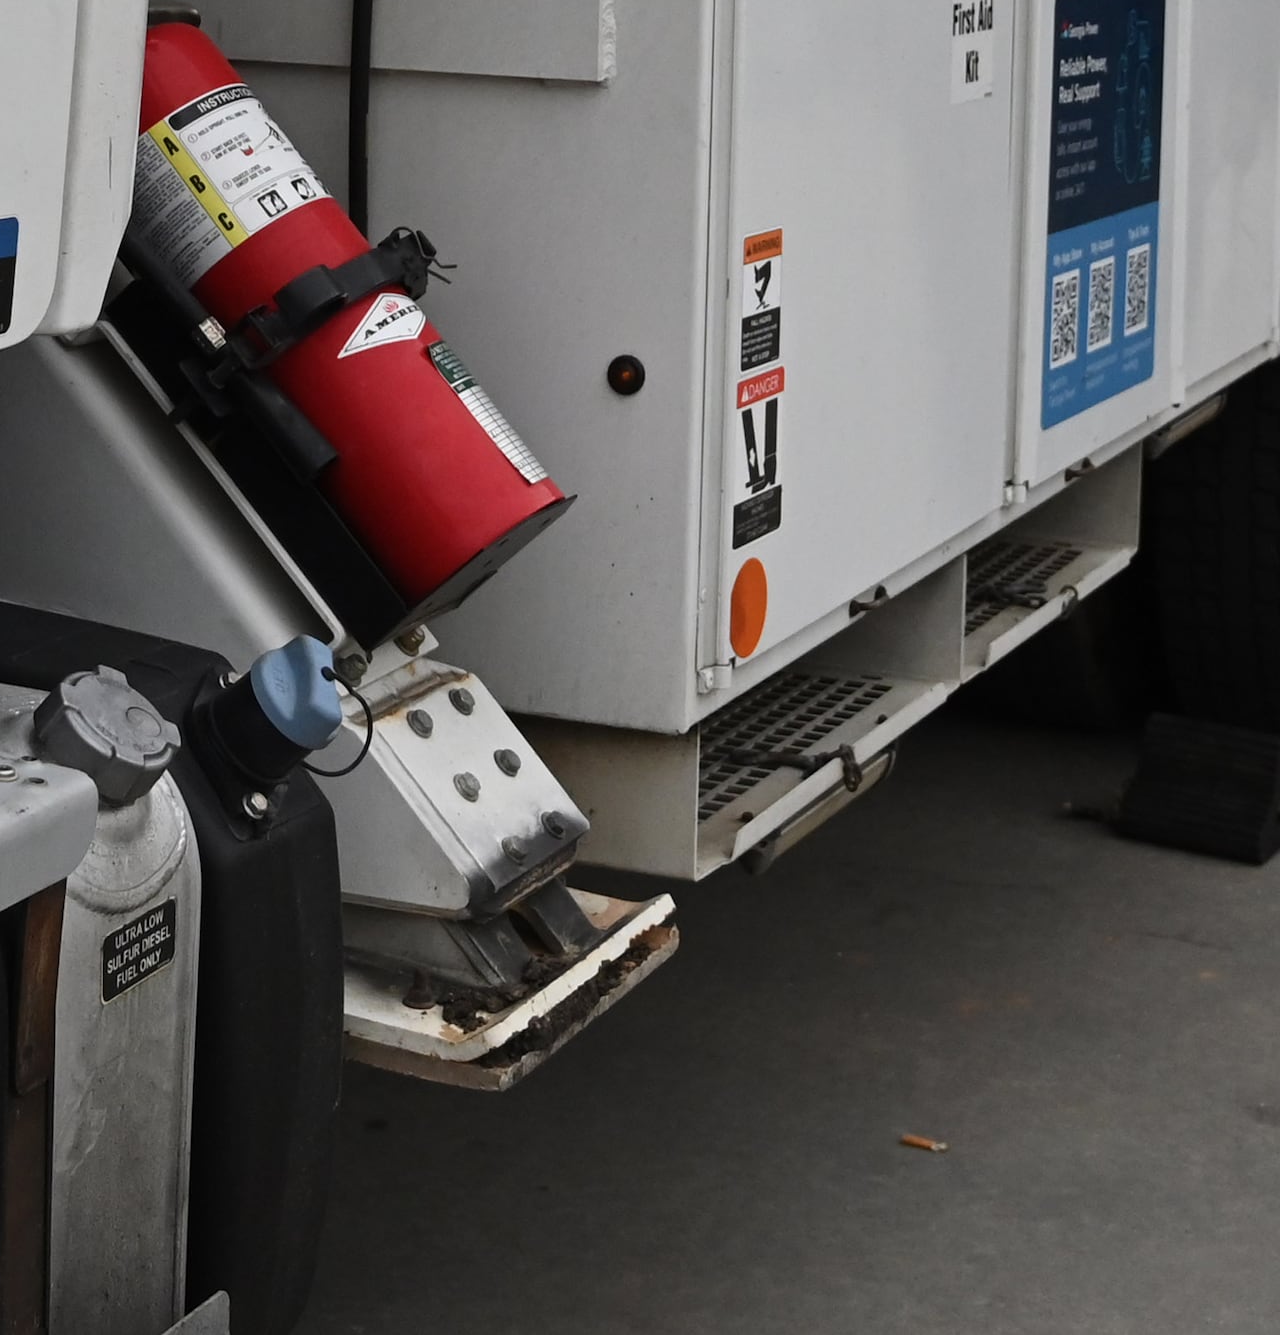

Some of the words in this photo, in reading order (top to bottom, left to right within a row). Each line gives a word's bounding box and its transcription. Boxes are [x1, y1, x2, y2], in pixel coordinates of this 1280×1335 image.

[952, 2, 975, 36] First
[965, 50, 979, 84] Kit
[1060, 57, 1086, 77] Reliable
[1059, 84, 1073, 104] Real
[1074, 80, 1100, 104] Support
[163, 136, 179, 156] A
[189, 174, 206, 194] B
[218, 213, 234, 231] C
[748, 374, 780, 399] DANGER
[114, 922, 143, 950] ULTRA
[143, 908, 165, 933] LOW
[106, 943, 140, 975] SULFUR
[141, 925, 171, 954] DIESEL
[116, 963, 139, 989] FUEL
[139, 947, 162, 973] ONLY
